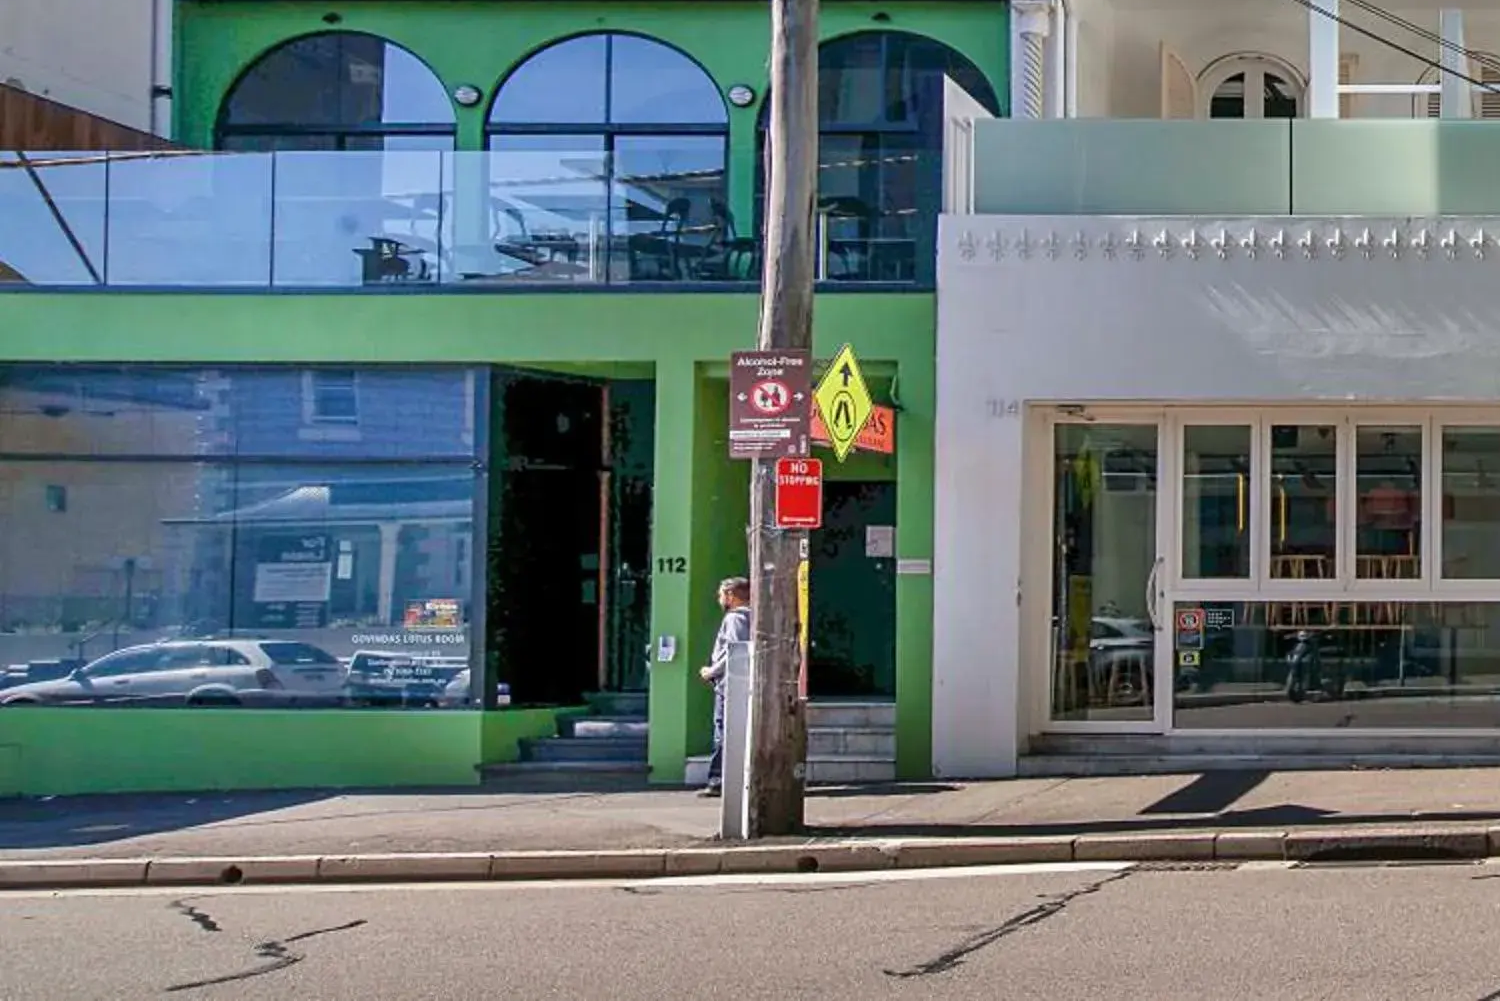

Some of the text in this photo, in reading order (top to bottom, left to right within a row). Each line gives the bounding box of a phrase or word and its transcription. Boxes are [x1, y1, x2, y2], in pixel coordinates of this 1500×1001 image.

[737, 356, 803, 367] Alcohol-Free
[757, 366, 783, 377] Zone
[790, 462, 808, 474] NO
[779, 474, 819, 486] STOPPING
[657, 557, 686, 573] 112
[351, 634, 465, 644] GOVINDAS LOTUS ROOM
